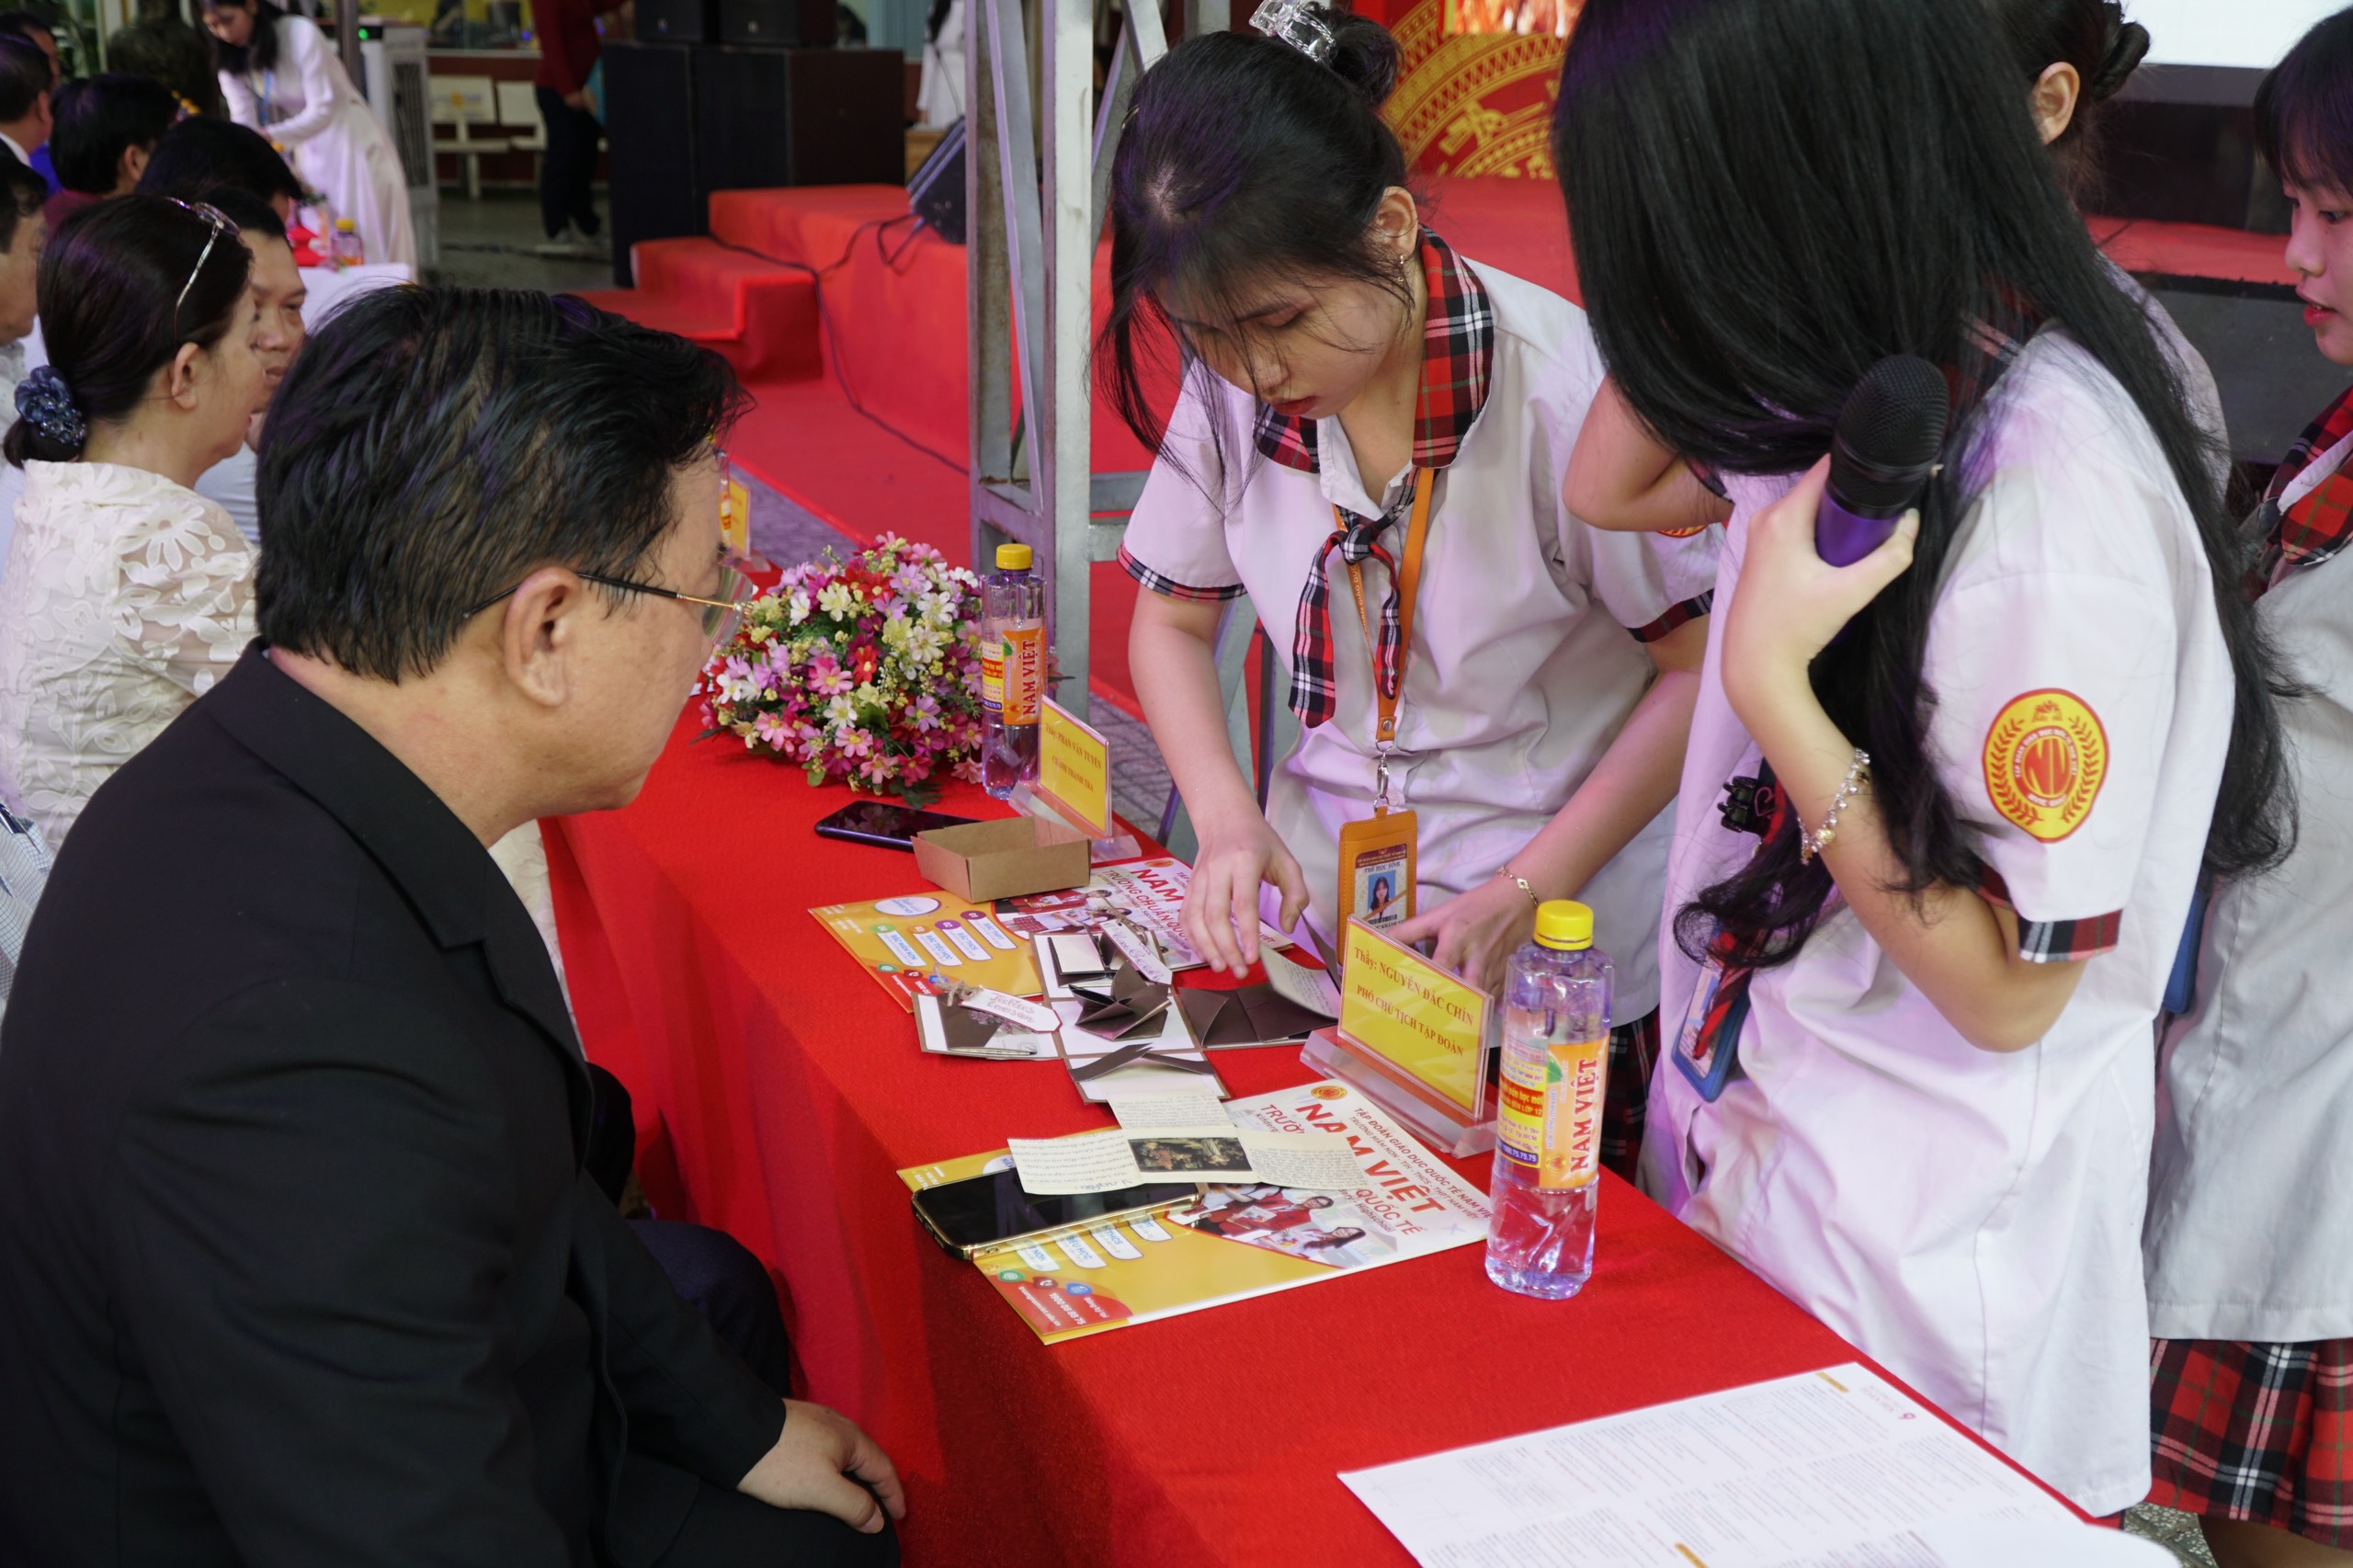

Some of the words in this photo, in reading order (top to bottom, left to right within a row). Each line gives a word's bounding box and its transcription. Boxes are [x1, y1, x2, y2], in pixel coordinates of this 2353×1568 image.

[1355, 585, 1364, 606] GIÁO
[1018, 641, 1038, 677] VIỆT
[1023, 681, 1036, 715] NAM
[1107, 869, 1142, 895] TRƯỜNG
[1130, 869, 1185, 903] NAM
[1355, 947, 1377, 970] Thầy:
[1380, 961, 1421, 995] NGUYỄN
[1423, 987, 1444, 1009] ĐẮC
[1446, 1002, 1473, 1026] CHÍN
[1357, 985, 1375, 1003] PHÓ
[1375, 996, 1393, 1015] CHỦ
[1395, 1008, 1416, 1029] TỊCH
[1418, 1022, 1436, 1040] TẬP
[1438, 1034, 1463, 1057] ĐOÀN
[1570, 1059, 1599, 1115] VIỆT
[1255, 1113, 1279, 1133] Kinderg
[1356, 1202, 1396, 1233] Highschool
[1260, 1104, 1305, 1133] TRƯỜ
[1356, 1188, 1406, 1221] QUỐC
[1395, 1220, 1428, 1235] TẾ
[1294, 1103, 1375, 1157] NAM
[1364, 1159, 1447, 1213] VIỆT
[1354, 1108, 1371, 1123] TẬP
[1369, 1119, 1392, 1139] ĐOÀN
[1389, 1138, 1411, 1154] GIÁO
[1407, 1153, 1427, 1169] DỤC
[1425, 1165, 1450, 1187] QUỐC
[1448, 1184, 1463, 1194] TẾ
[1460, 1193, 1480, 1210] NAM
[1477, 1206, 1494, 1221] VIỆ
[1570, 1118, 1592, 1173] NAM
[1384, 1146, 1399, 1159] NON
[1414, 1172, 1431, 1185] THCS
[1432, 1187, 1450, 1200] THPT
[1448, 1199, 1463, 1210] NAM
[1049, 1292, 1065, 1308] 1900
[1074, 1313, 1086, 1325] 75
